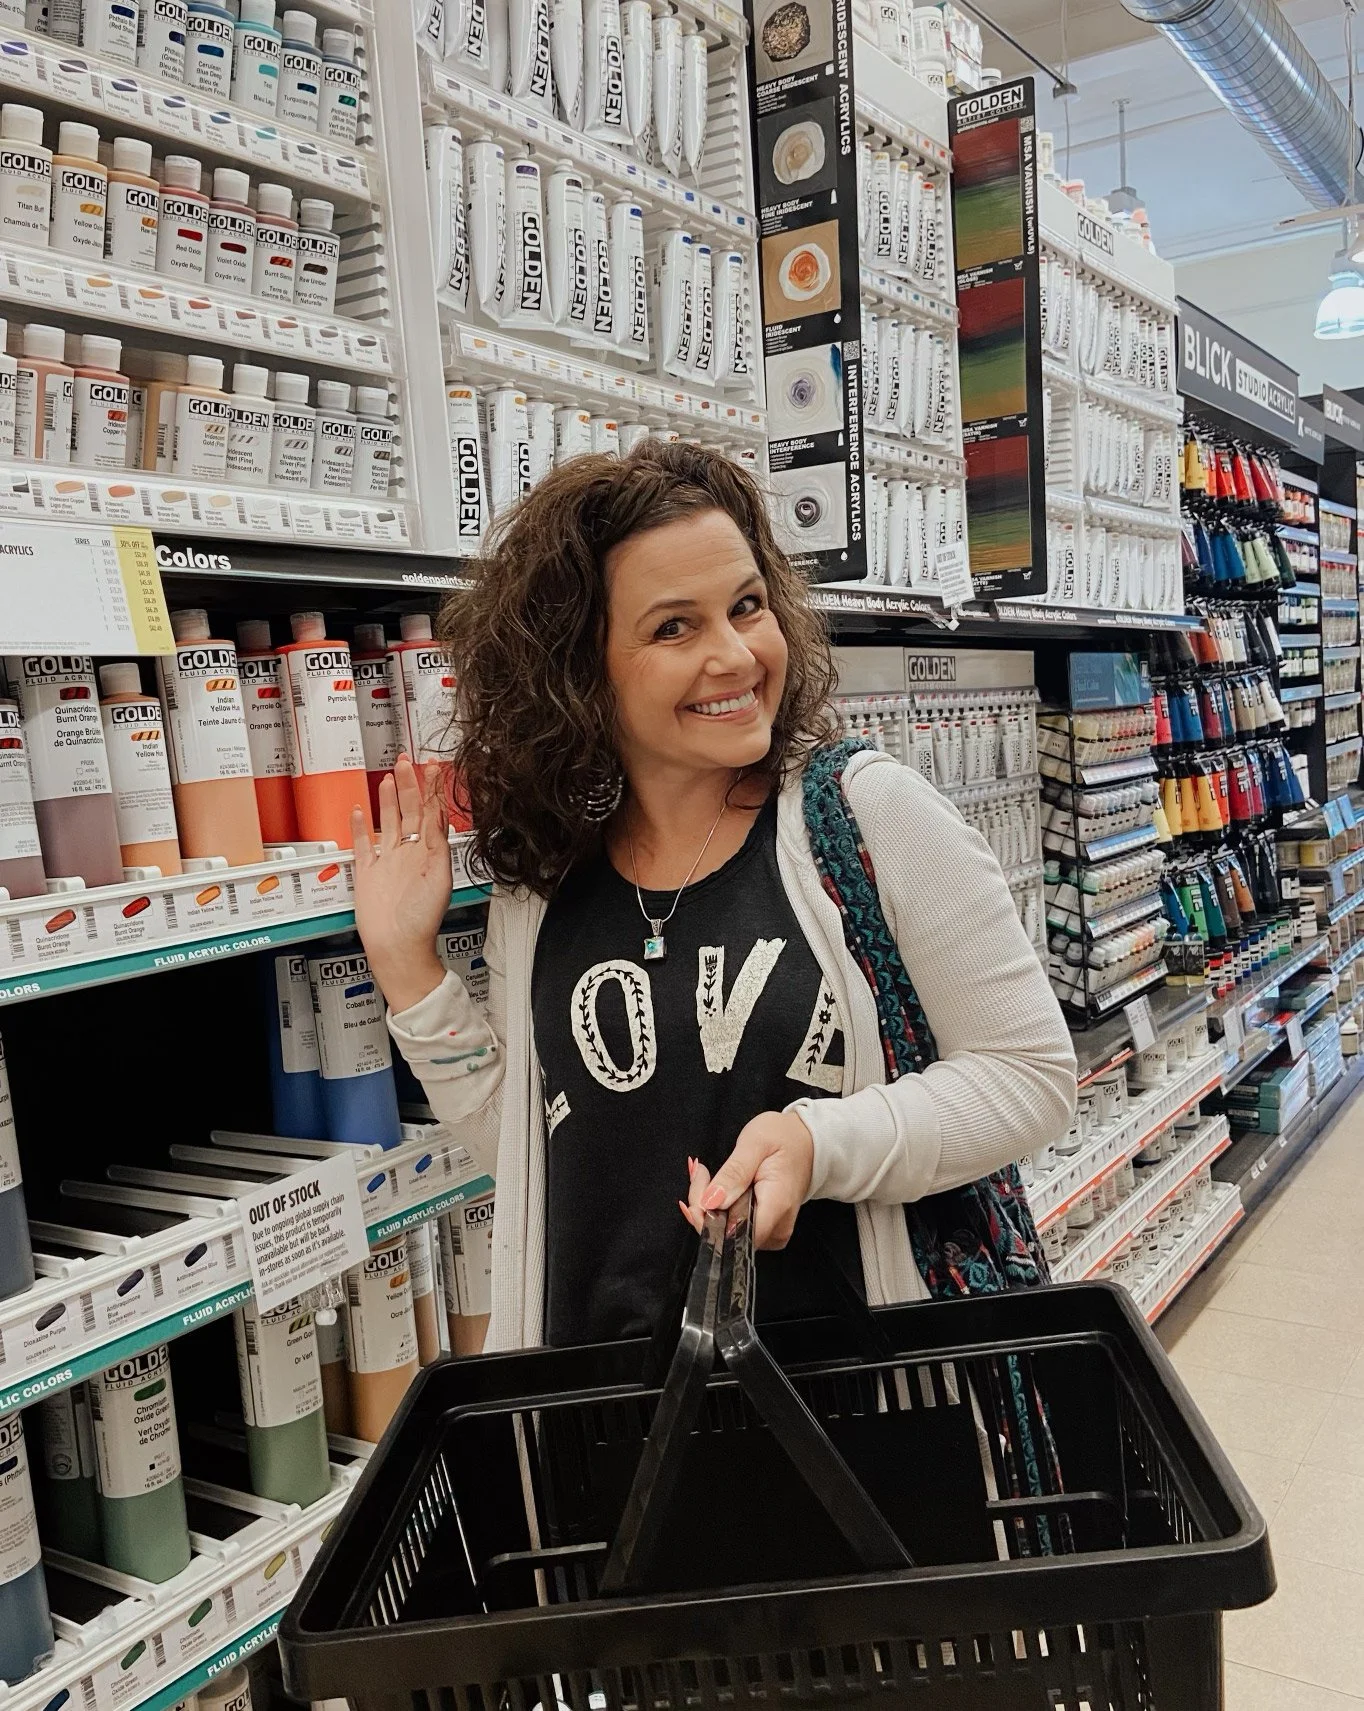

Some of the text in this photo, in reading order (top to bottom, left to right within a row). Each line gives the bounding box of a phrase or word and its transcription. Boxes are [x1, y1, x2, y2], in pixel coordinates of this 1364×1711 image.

[605, 36, 622, 124] GOLDEN
[957, 87, 1023, 117] GOLDEN
[838, 84, 851, 155] ACRYLICS
[1024, 136, 1035, 216] MSA VARNISH
[18, 201, 32, 211] Titan
[761, 204, 781, 214] HEAVY
[3, 217, 30, 228] Chamois
[878, 191, 891, 256] GOLDEN
[1078, 213, 1113, 255] GOLDEN
[923, 219, 936, 280] GOLDEN
[217, 256, 232, 266] Violet
[521, 212, 542, 310] GOLDEN
[215, 271, 232, 282] Oxyde
[265, 269, 278, 279] Burnt
[571, 229, 587, 320] GOLDEN
[594, 240, 613, 333] GOLDEN
[632, 256, 645, 342] GOLDEN
[677, 279, 692, 361] GOLDEN
[695, 286, 711, 369] GOLDEN
[1184, 323, 1295, 417] BLICK STUDIO ACRYLIC
[92, 386, 129, 404] GOLD
[887, 357, 899, 420] GOLDEN
[847, 364, 862, 547] INTERFERENCE ACRYLICS
[458, 438, 480, 536] GOLDEN
[156, 545, 232, 571] Colors
[841, 594, 866, 610] Heavy
[866, 596, 885, 611] Body
[886, 598, 909, 613] Acrylic
[910, 600, 932, 612] Colors
[908, 656, 956, 681] GOLDEN
[26, 675, 57, 685] FLUID
[217, 696, 235, 705] Indian
[252, 703, 274, 713] Pyrrole
[328, 695, 346, 705] Pyrrole
[55, 704, 97, 717] Quinacridone
[211, 704, 230, 713] Yellow
[56, 713, 98, 724] Burnt Orange
[198, 716, 238, 728] Teinte Jaune
[325, 715, 345, 725] Orange
[366, 720, 383, 730] Rouge
[57, 729, 84, 742] Orange
[250, 722, 271, 733] Orange
[54, 739, 64, 748] de
[142, 743, 158, 751] Indian
[135, 750, 154, 760] Yellow
[36, 933, 70, 947] Quinacridone
[114, 926, 146, 938] Burnt Orange
[36, 940, 71, 953] Burnt Orange
[155, 935, 271, 968] FLUID ACRYLIC COLORS
[322, 978, 348, 987] FLUID
[345, 1000, 365, 1010] Cobalt
[344, 1019, 358, 1029] Bleu
[359, 1018, 367, 1027] de
[249, 1179, 322, 1225] OUT OF STOCK
[252, 1193, 345, 1242] Due to ongoing global supply chain
[377, 1191, 465, 1238] FLUID ACRYLIC COLORS
[255, 1206, 342, 1254] issues, this product is temporarily
[257, 1223, 331, 1265] unavailable but will be back
[259, 1229, 346, 1278] in-stores as soon as it's available.
[177, 1260, 219, 1283] Anthraquinone Blue
[364, 1270, 389, 1280] FLUID
[106, 1293, 141, 1313] Anthraquinone
[386, 1290, 404, 1302] Yellow
[107, 1310, 119, 1320] Blue
[183, 1305, 214, 1327] FLUID
[261, 1313, 288, 1325] FLUID
[391, 1310, 403, 1321] Ocre
[23, 1325, 67, 1348] Dioxazine Purple
[286, 1333, 303, 1347] Green
[294, 1351, 314, 1366] Or Vert
[23, 1368, 74, 1399] COLORS
[106, 1379, 134, 1391] FLUID
[133, 1403, 171, 1425] Oxide Green
[136, 1397, 167, 1415] Chromium
[138, 1426, 152, 1438] Vert
[139, 1436, 147, 1446] de
[207, 1655, 239, 1678] FLUID
[110, 1670, 133, 1688] Chromium
